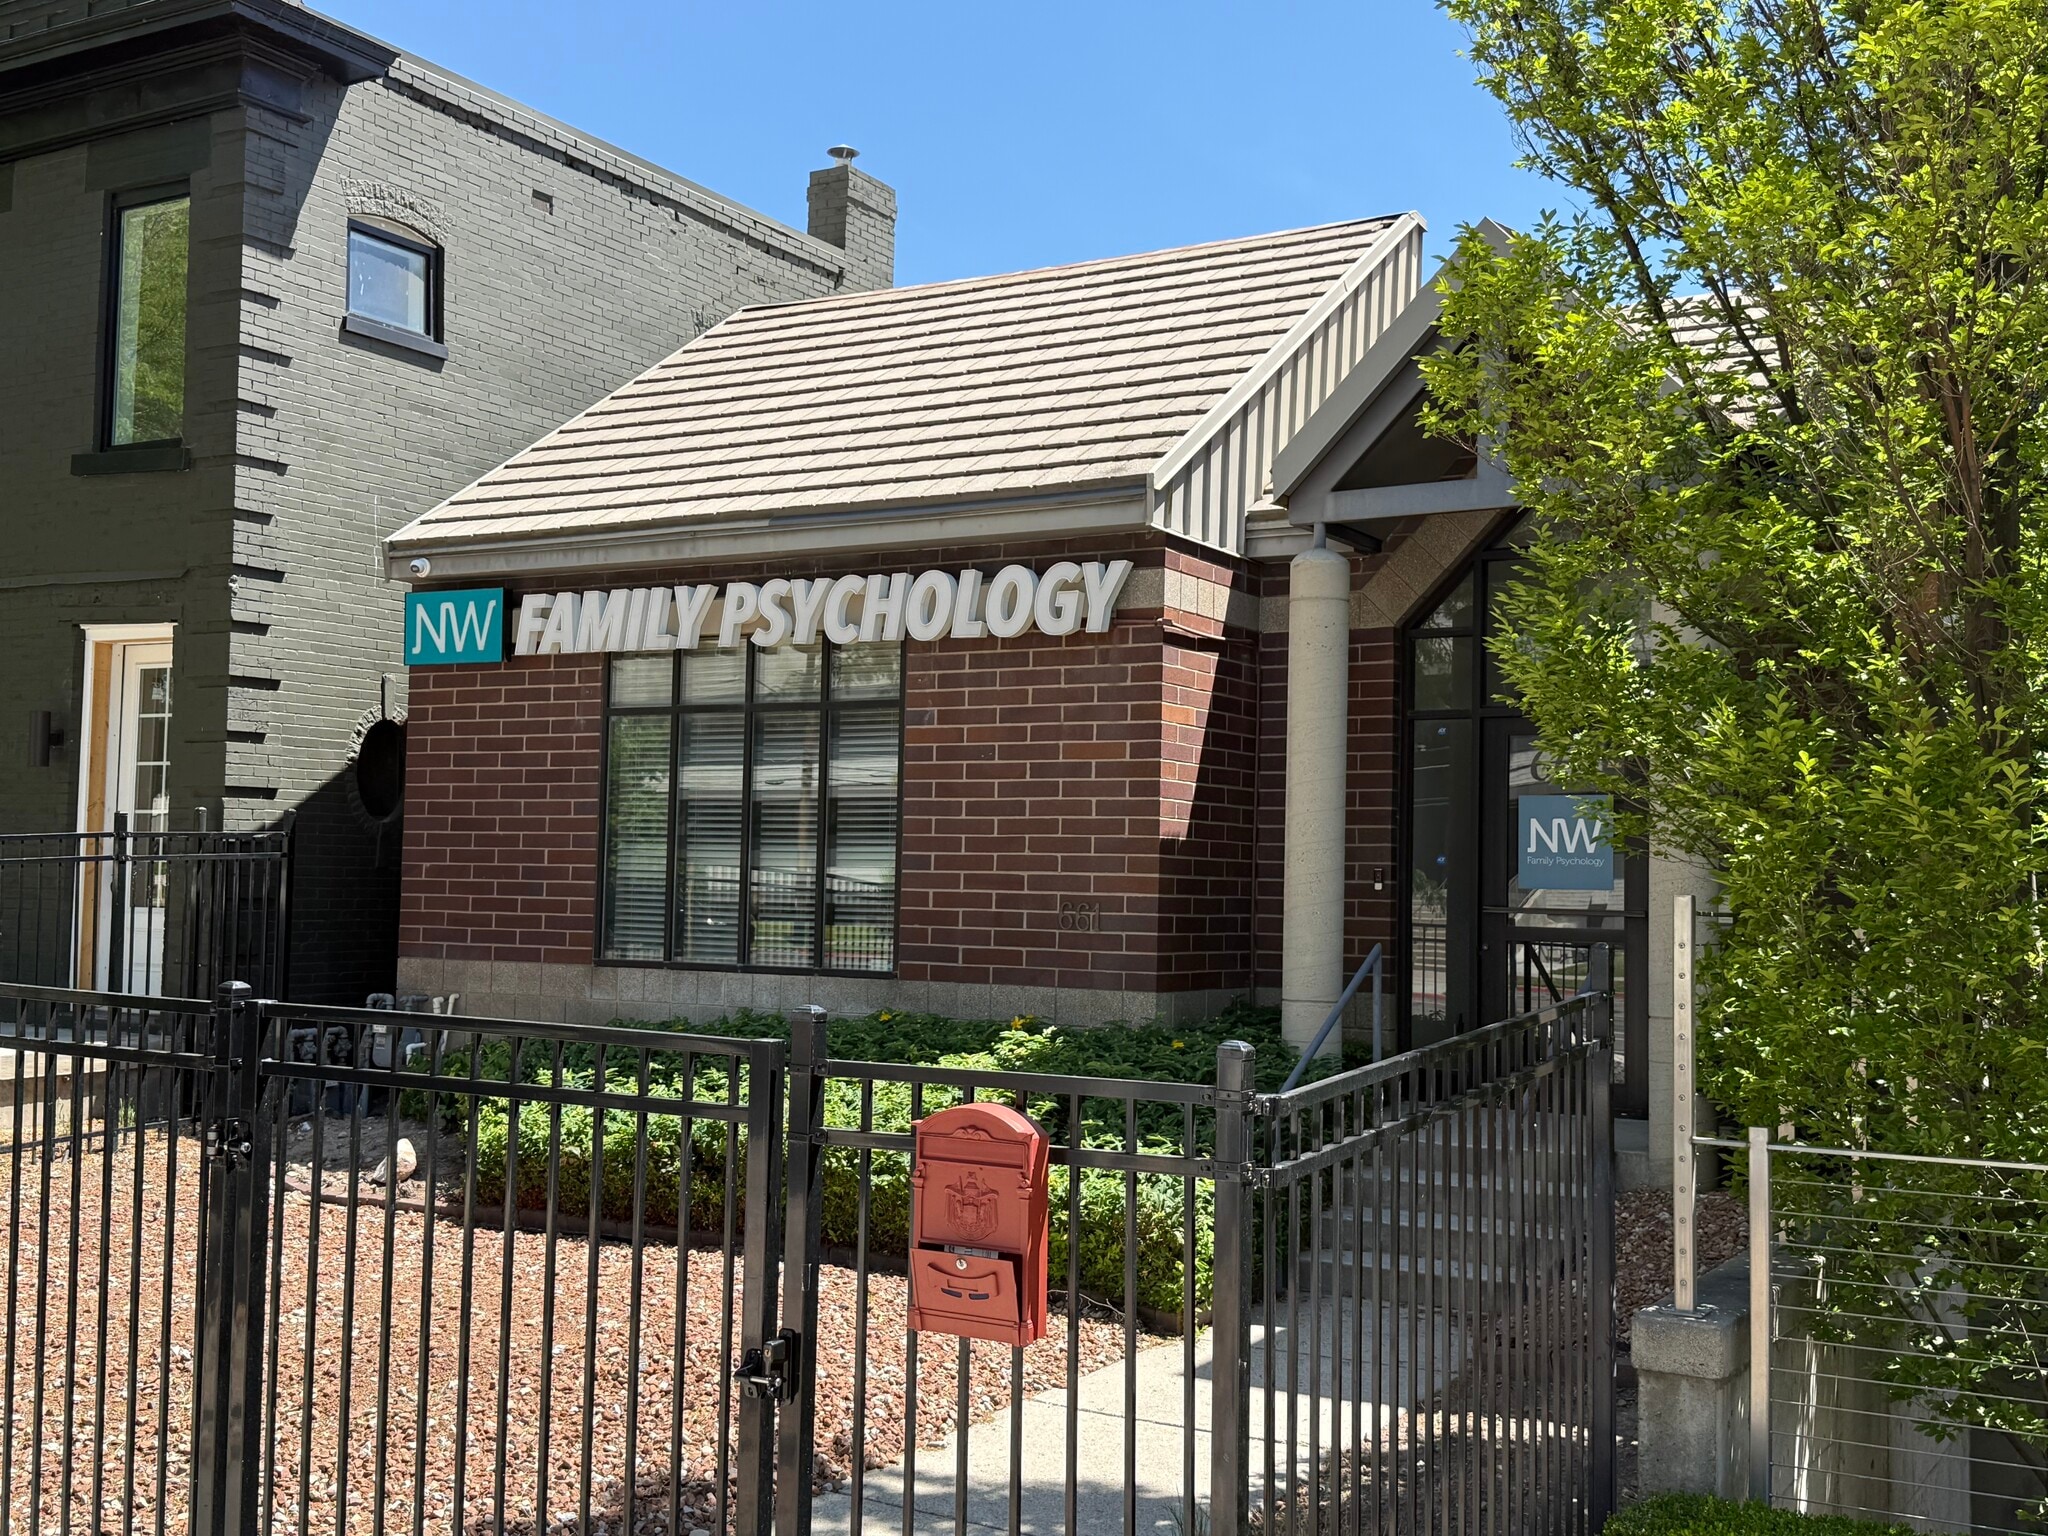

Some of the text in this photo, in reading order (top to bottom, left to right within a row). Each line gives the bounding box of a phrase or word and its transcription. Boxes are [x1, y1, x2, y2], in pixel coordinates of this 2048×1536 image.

[514, 559, 1134, 656] FAMILY PSYCHOLOGY
[412, 600, 497, 655] NW
[1527, 818, 1604, 854] NW
[1527, 856, 1605, 868] Family Psychology
[1059, 901, 1100, 932] 661
